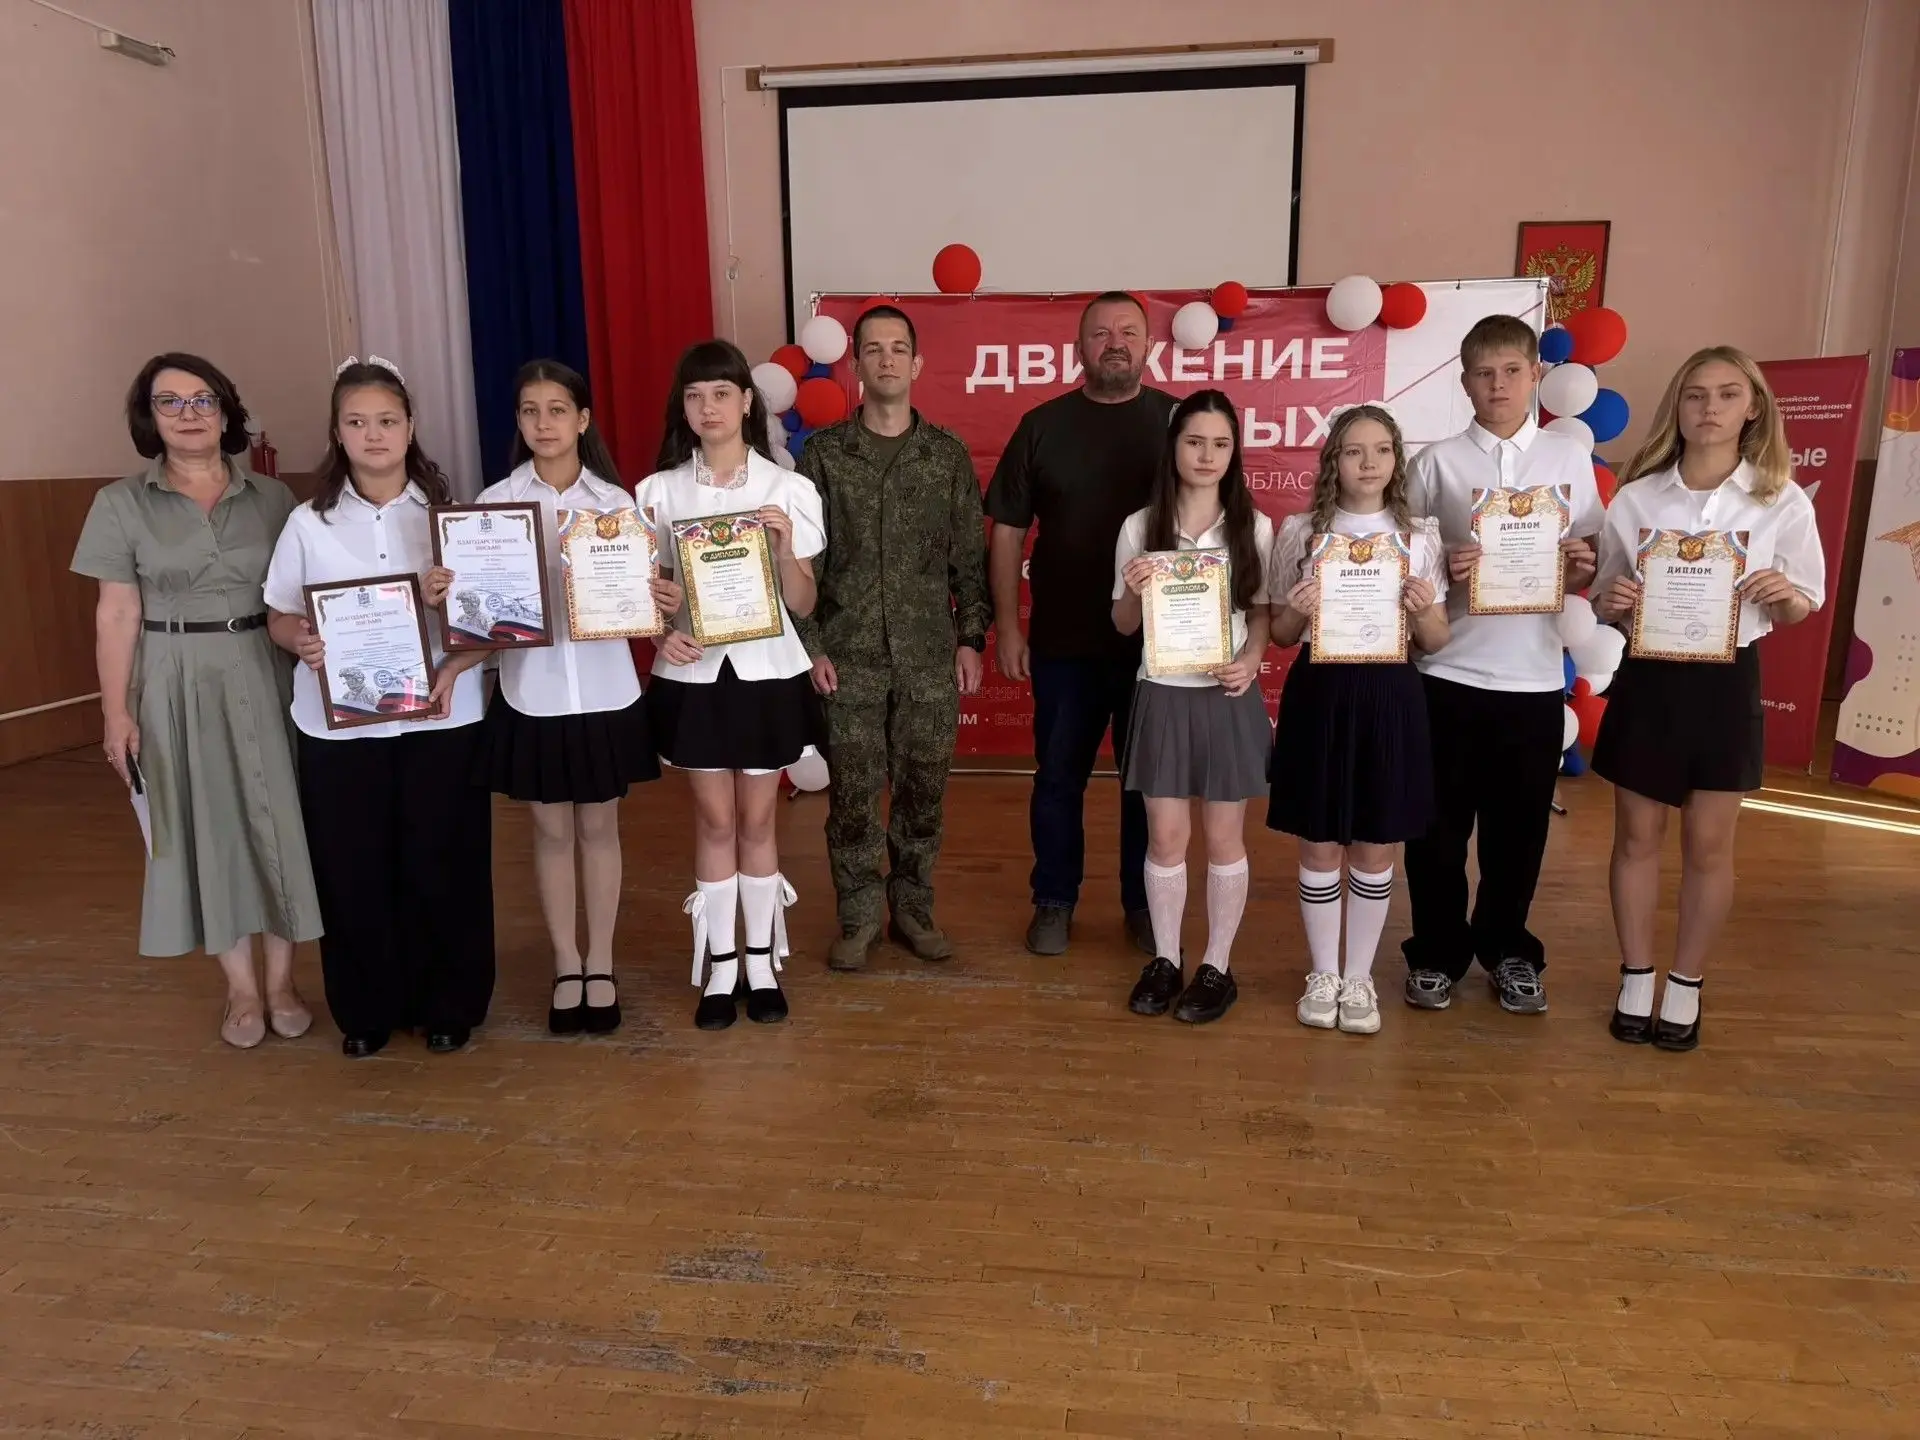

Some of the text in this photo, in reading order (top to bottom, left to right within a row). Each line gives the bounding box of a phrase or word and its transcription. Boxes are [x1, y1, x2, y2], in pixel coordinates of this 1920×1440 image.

[1775, 395, 1820, 403] ссийское
[1243, 471, 1320, 490] БЛАС
[1500, 521, 1540, 531] ДИПЛОМ
[590, 544, 630, 554] ДИПЛОМ
[710, 549, 741, 560] ДИПЛОМ
[1340, 568, 1380, 577] ДИПЛОМ
[1667, 566, 1712, 575] ДИПЛОМ
